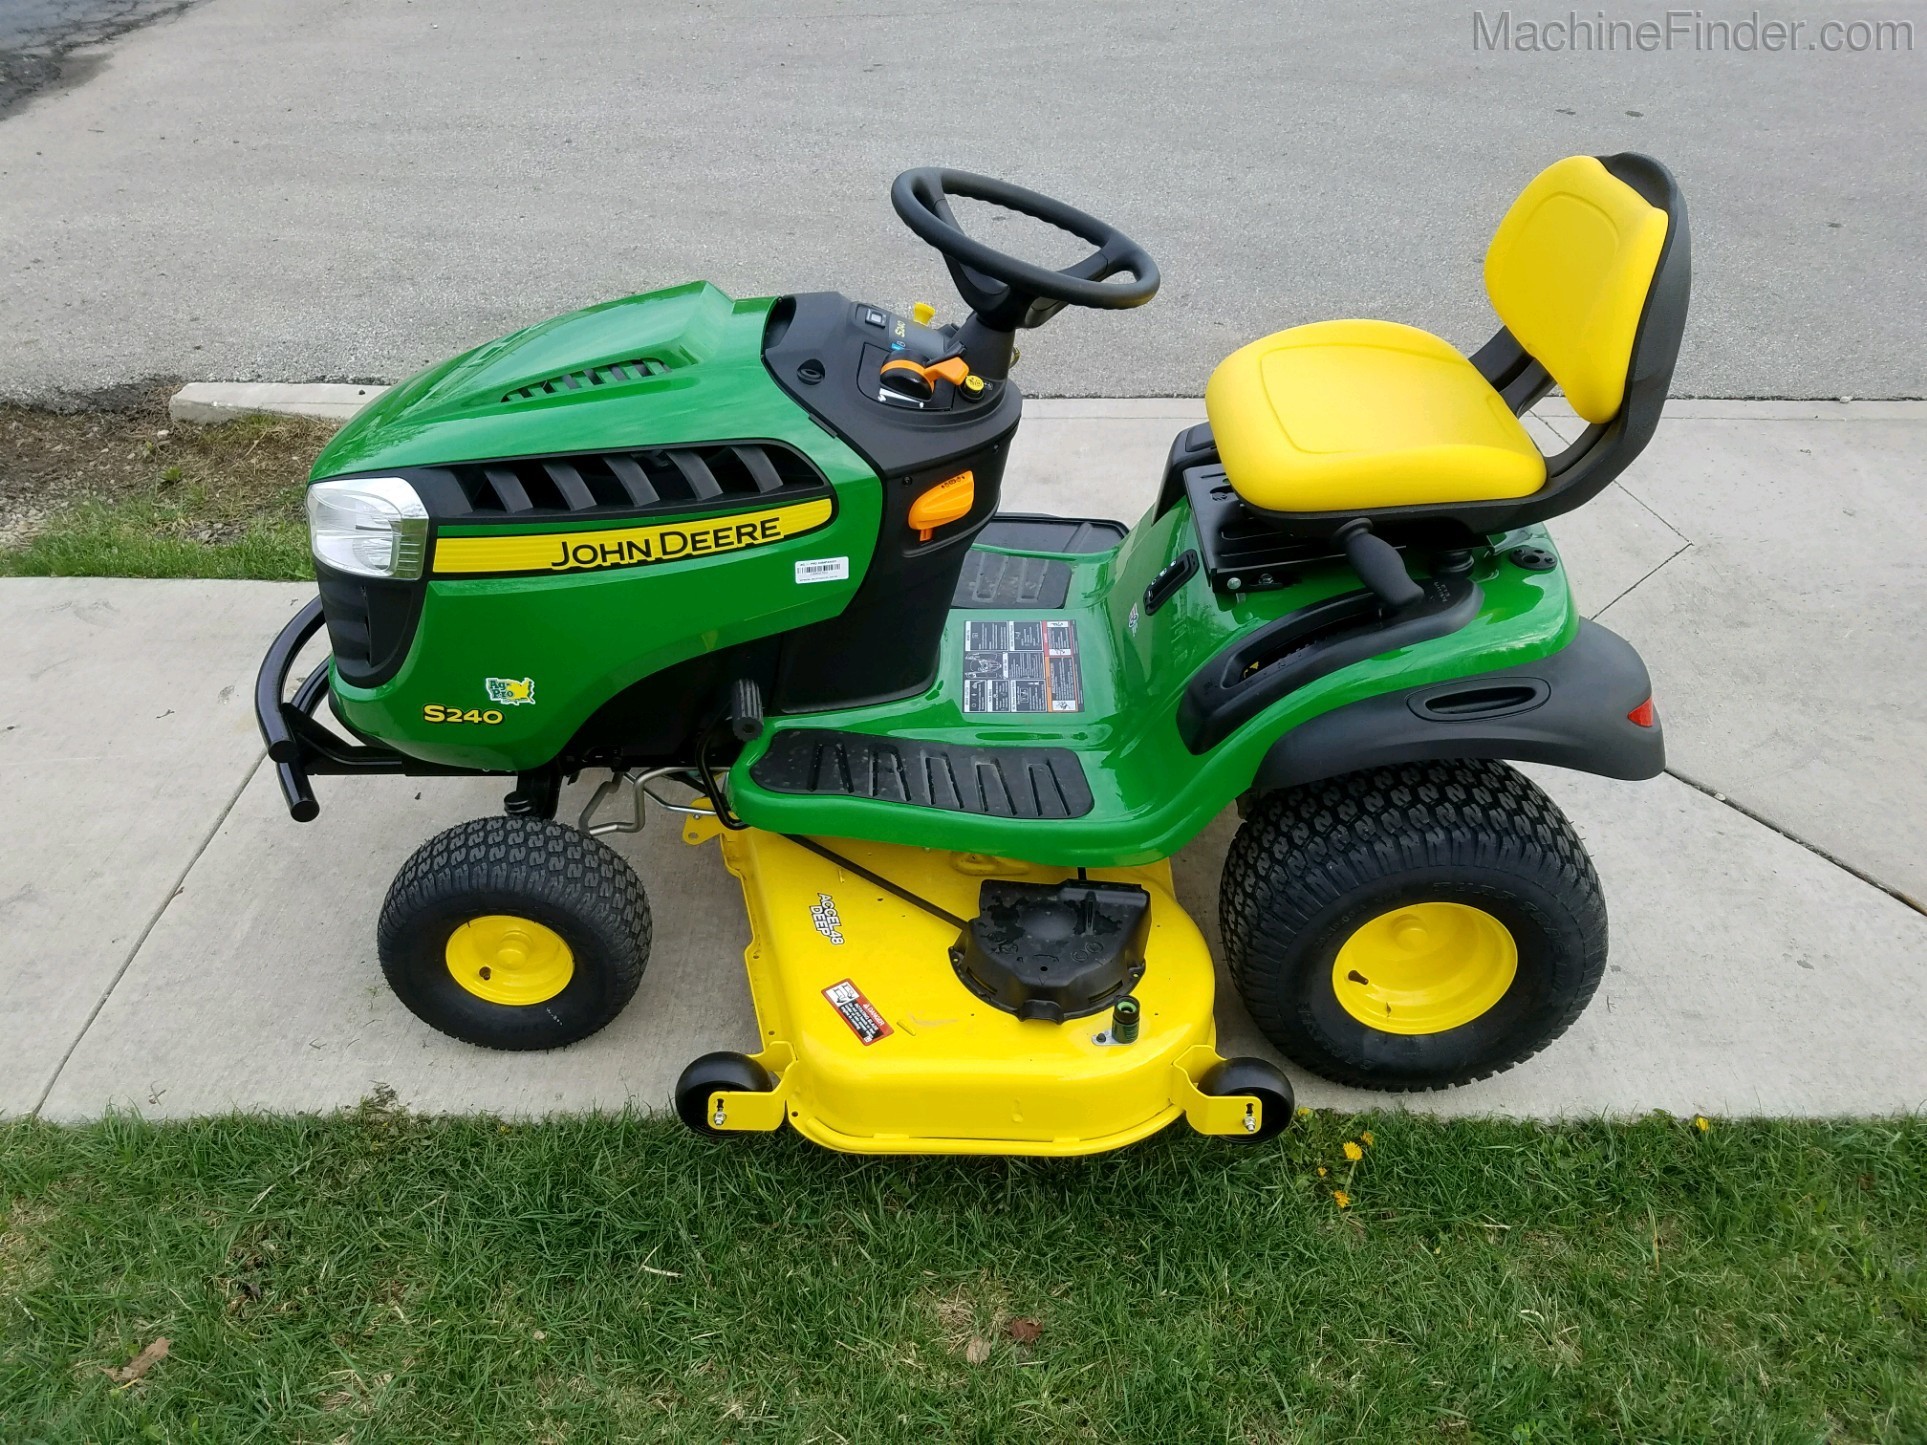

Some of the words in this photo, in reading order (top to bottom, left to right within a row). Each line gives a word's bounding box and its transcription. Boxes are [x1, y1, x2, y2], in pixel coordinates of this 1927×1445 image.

[551, 541, 652, 568] JOHN
[660, 517, 782, 555] DEERE
[492, 689, 514, 699] Pro
[423, 704, 503, 725] S240
[809, 905, 831, 937] DEEP
[817, 893, 842, 930] ACCEL
[830, 930, 845, 945] 48
[867, 1006, 885, 1026] DANGER
